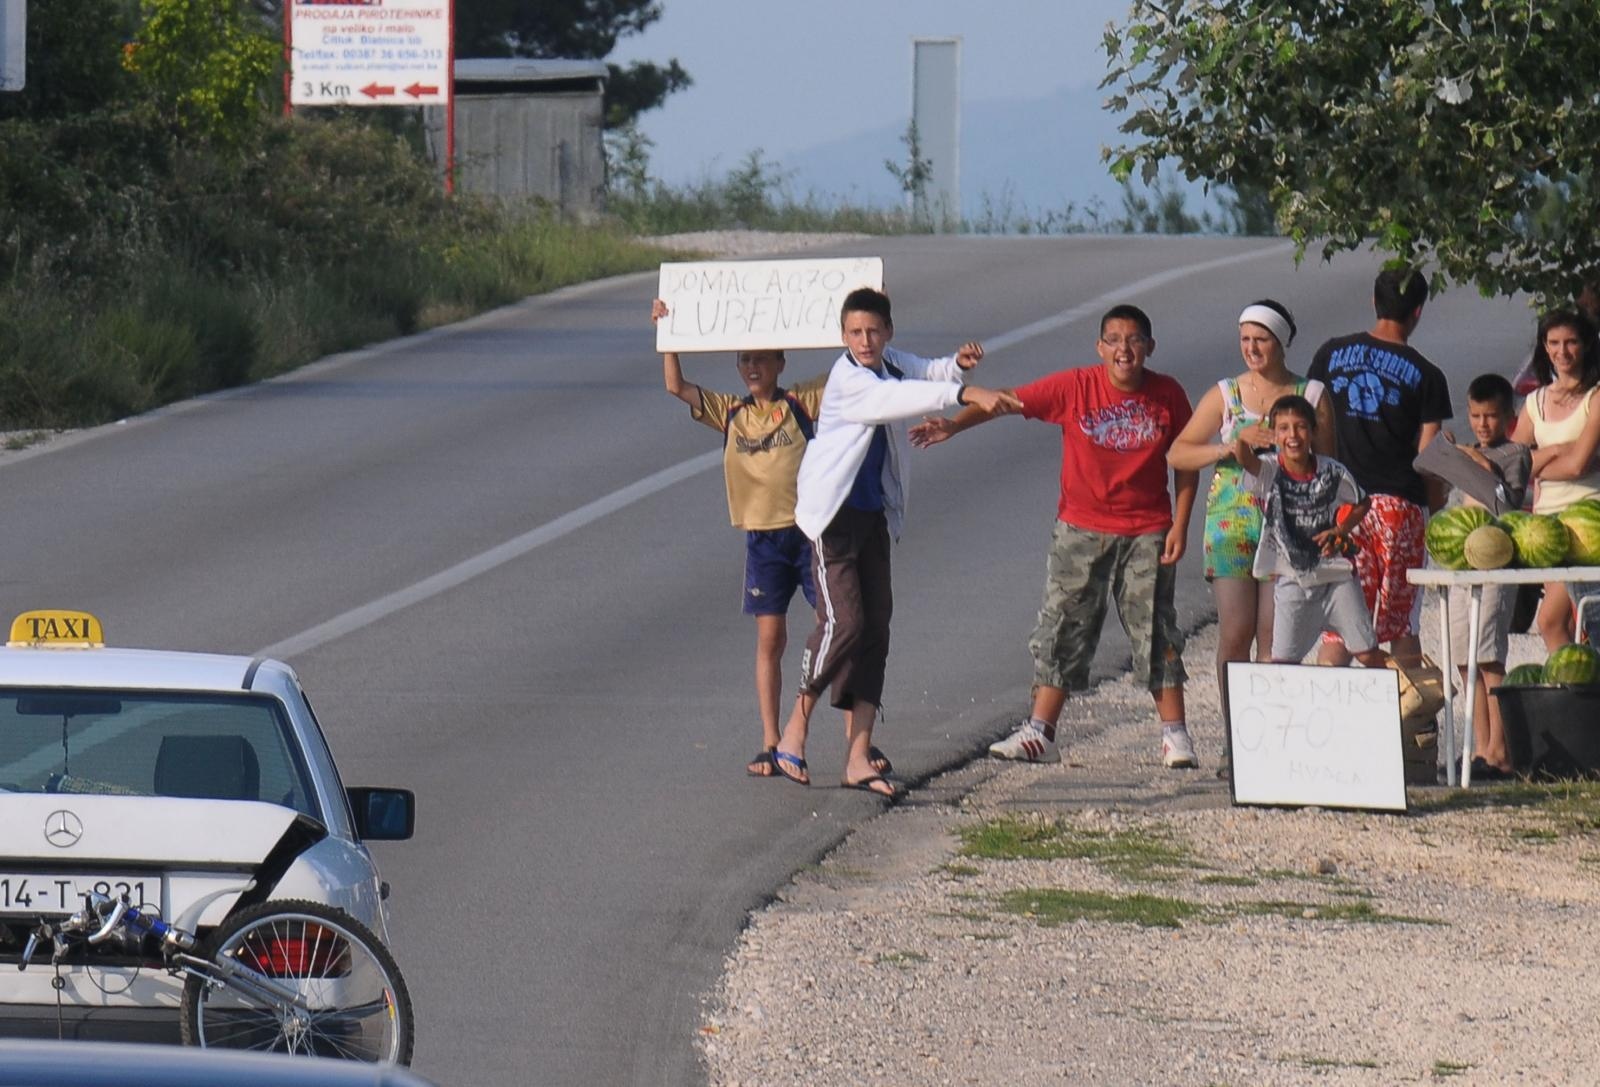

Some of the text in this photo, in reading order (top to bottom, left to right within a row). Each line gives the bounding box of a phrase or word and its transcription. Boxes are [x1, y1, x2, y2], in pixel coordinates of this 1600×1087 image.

[295, 8, 441, 19] PRODAJA PIROTEHNIKE
[322, 25, 337, 33] na
[341, 23, 374, 33] veliko
[303, 80, 351, 97] 3 Km
[669, 291, 841, 337] LUBENICA
[26, 617, 90, 639] TAXI
